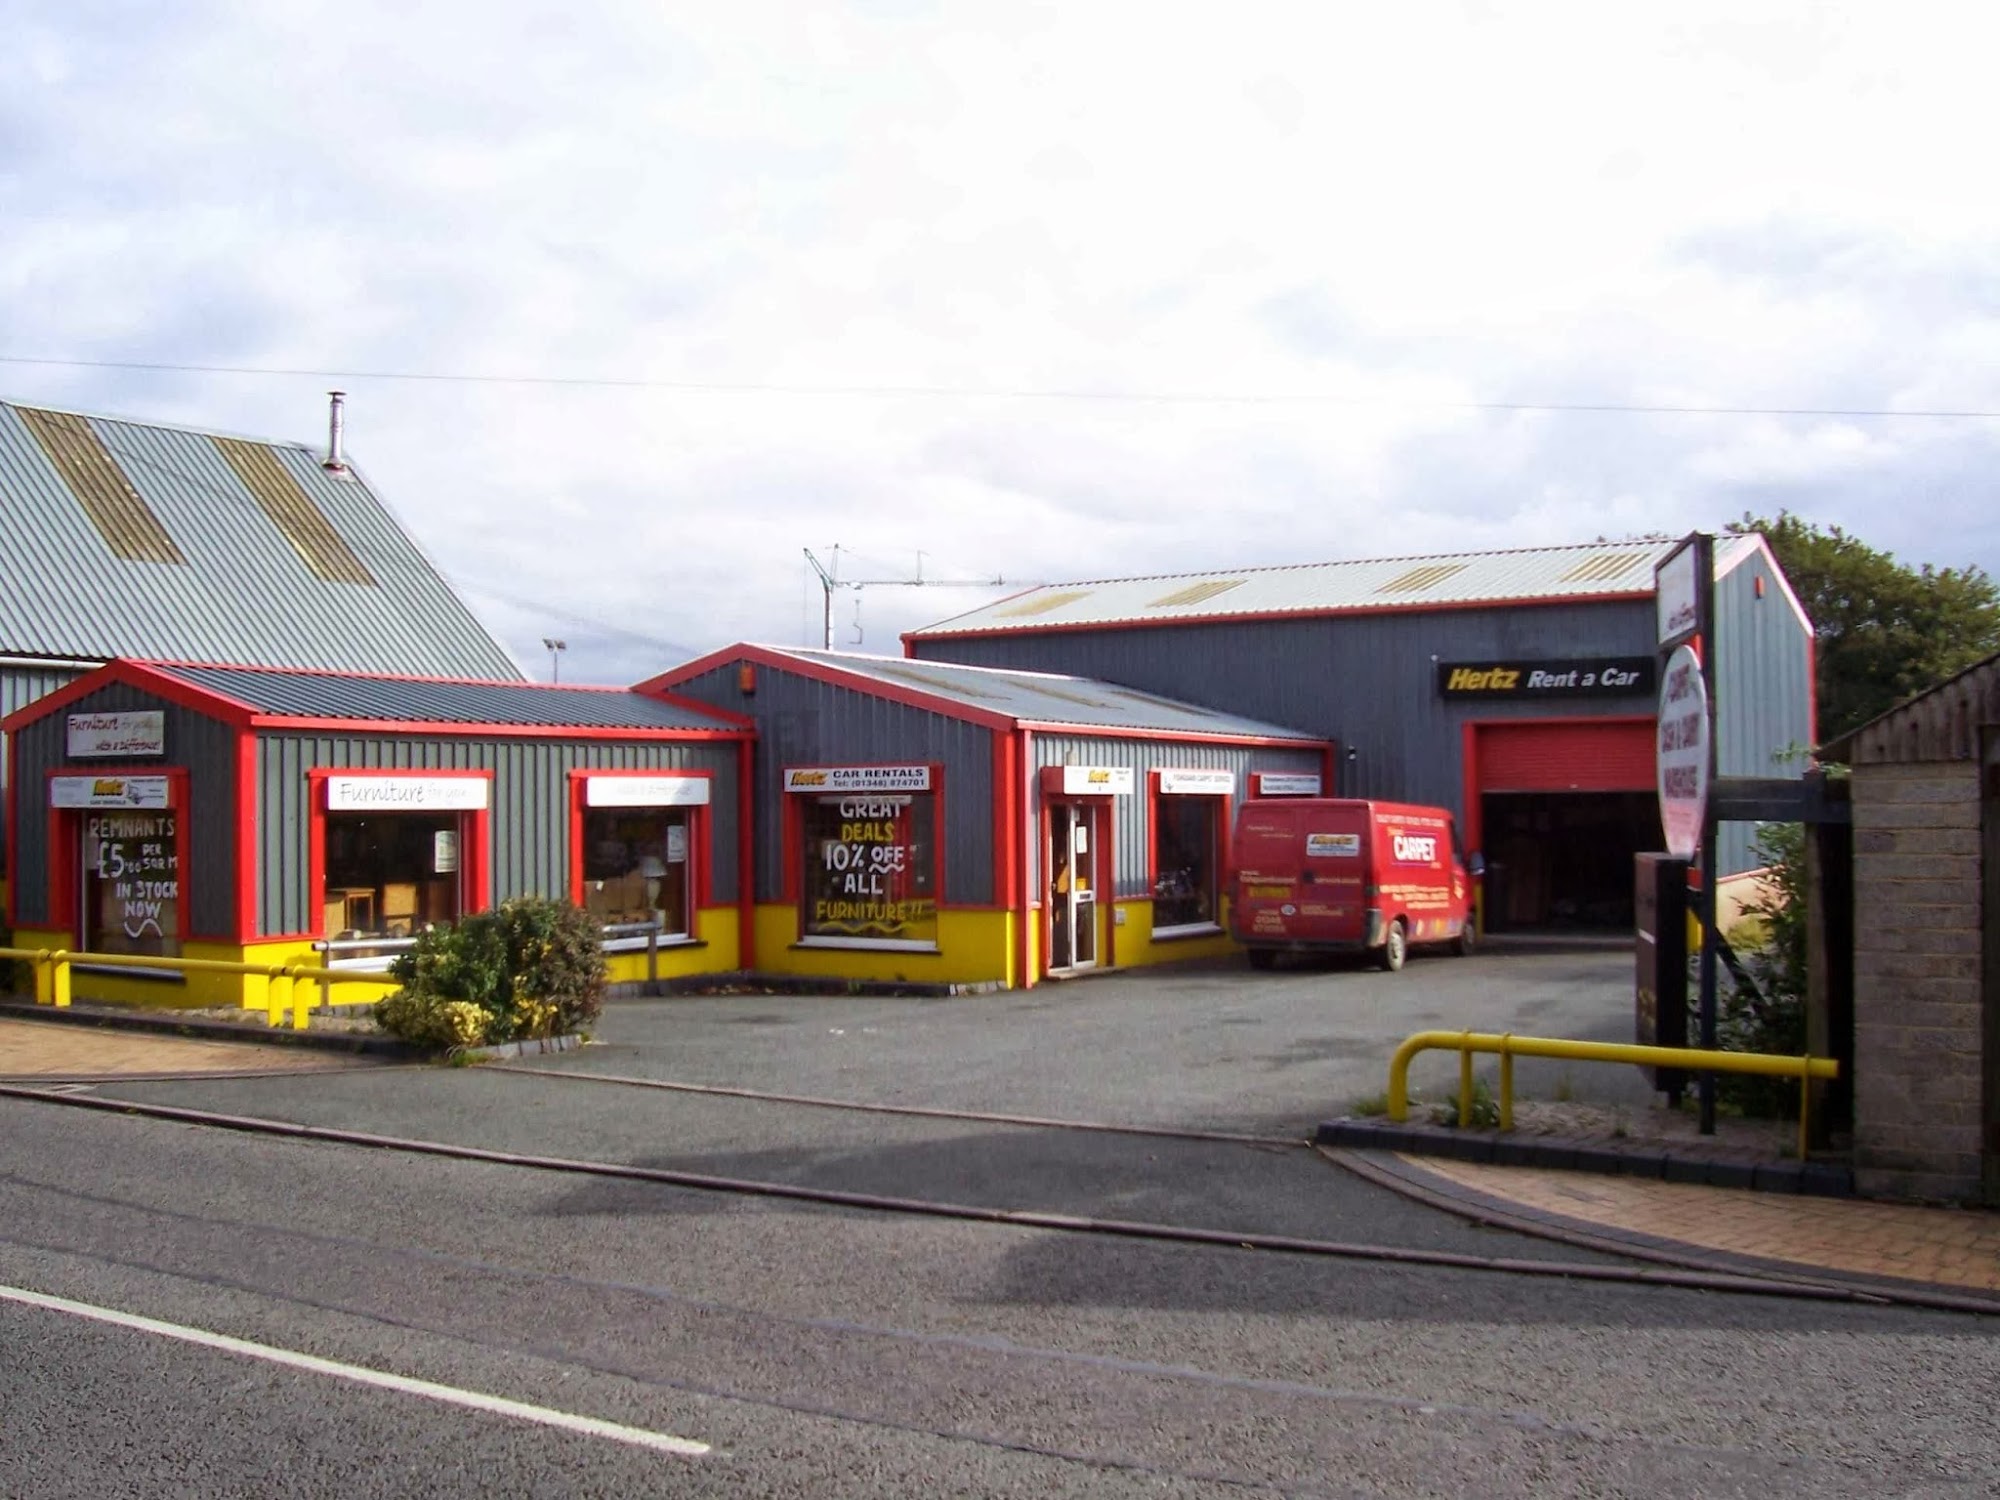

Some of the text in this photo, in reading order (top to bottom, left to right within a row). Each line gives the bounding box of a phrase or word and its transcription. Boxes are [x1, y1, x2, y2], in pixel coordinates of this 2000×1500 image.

[1447, 666, 1640, 690] Hertz Rent a Car
[68, 714, 118, 731] Furniture
[833, 768, 924, 778] CAR RENTALS
[340, 779, 425, 803] Furniture
[840, 801, 902, 818] GREAT
[89, 817, 175, 839] REMNANTS
[841, 822, 895, 842] DEALS
[142, 843, 162, 856] PER
[825, 844, 905, 871] 10% OFF
[1393, 835, 1437, 861] CARPET
[116, 881, 178, 900] IN STOCK
[843, 874, 884, 895] ALL
[124, 901, 162, 918] NOW
